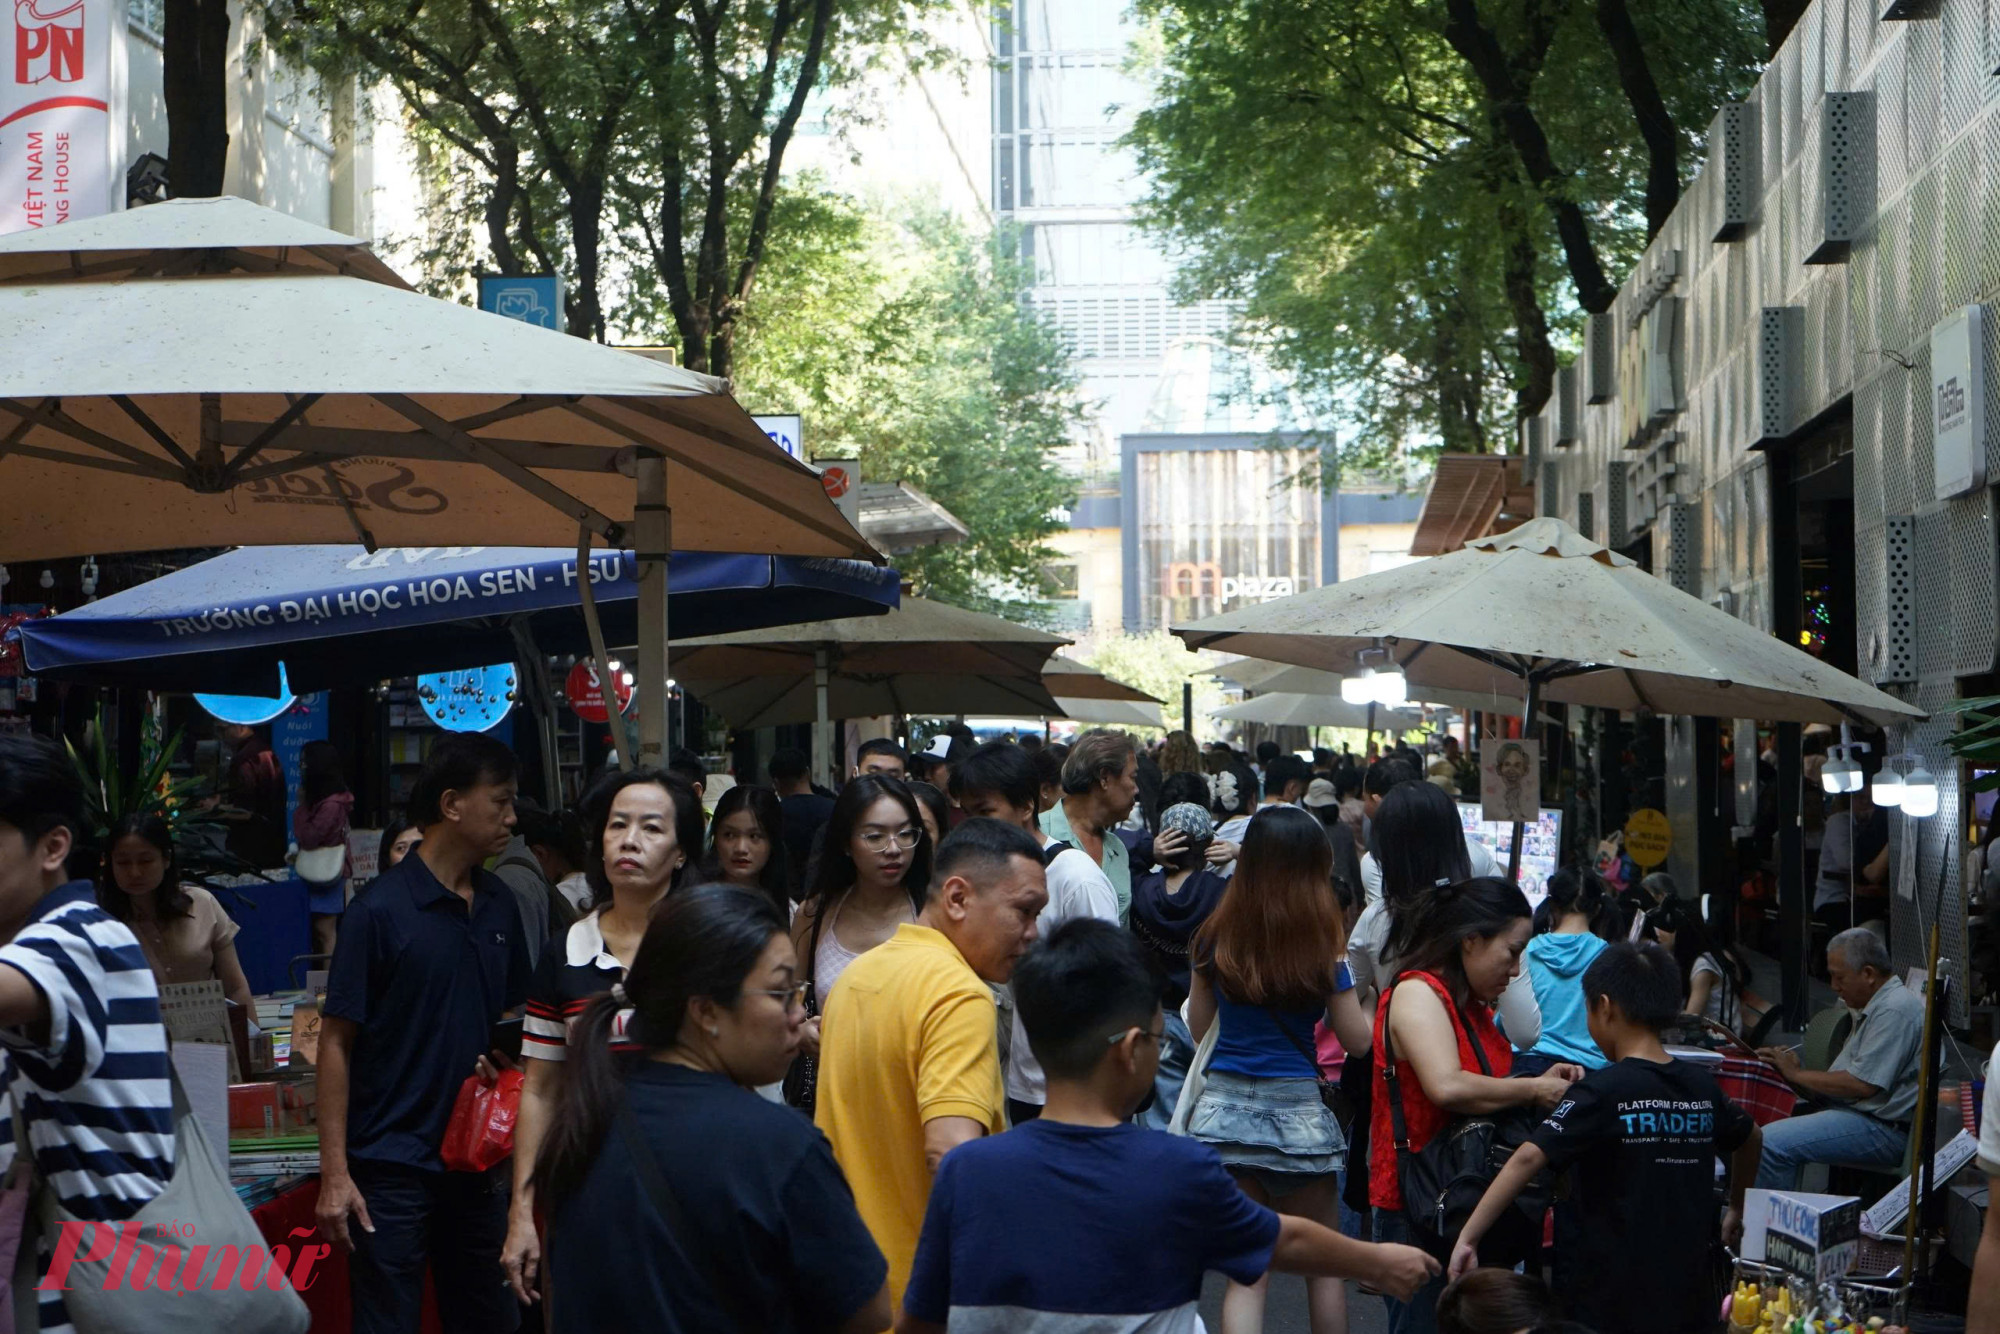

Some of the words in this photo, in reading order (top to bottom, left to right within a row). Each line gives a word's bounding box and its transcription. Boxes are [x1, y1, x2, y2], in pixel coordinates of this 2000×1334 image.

[27, 132, 43, 181] NAM
[53, 132, 69, 193] HOUSE
[153, 605, 275, 637] TRƯỜNG
[280, 595, 333, 625] ĐẠI
[337, 584, 403, 618] HỌC
[408, 575, 475, 607] HOA
[479, 566, 537, 597] SEN
[562, 556, 621, 587] HSU
[1617, 1100, 1670, 1111] PLATFORM
[1672, 1101, 1691, 1110] FOR
[1619, 1112, 1714, 1134] TRADERS
